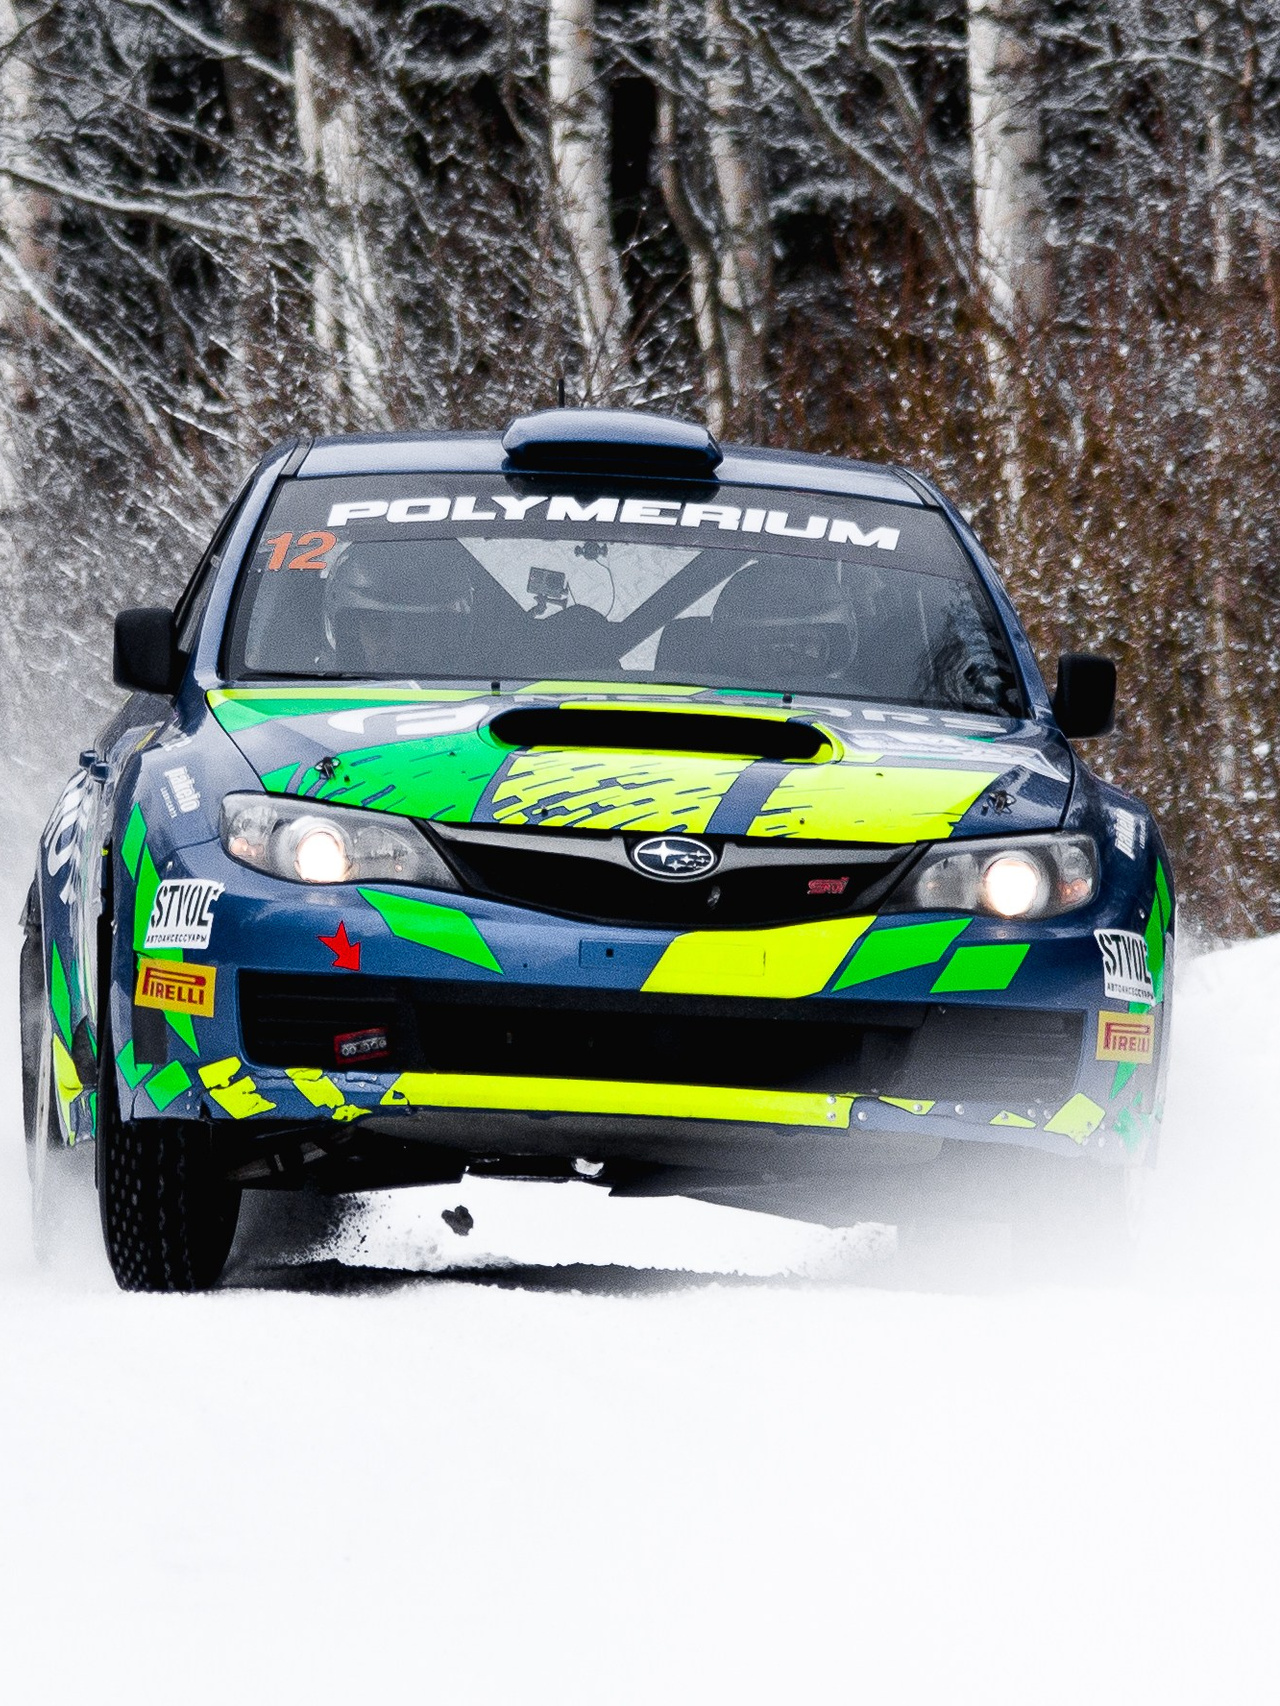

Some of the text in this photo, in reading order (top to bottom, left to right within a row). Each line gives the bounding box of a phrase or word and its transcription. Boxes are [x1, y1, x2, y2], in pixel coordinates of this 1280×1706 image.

[327, 496, 900, 550] POLYMERIUM
[267, 531, 337, 571] 12
[142, 966, 207, 1006] PIRELLI
[1103, 1022, 1150, 1052] PIRELLI
